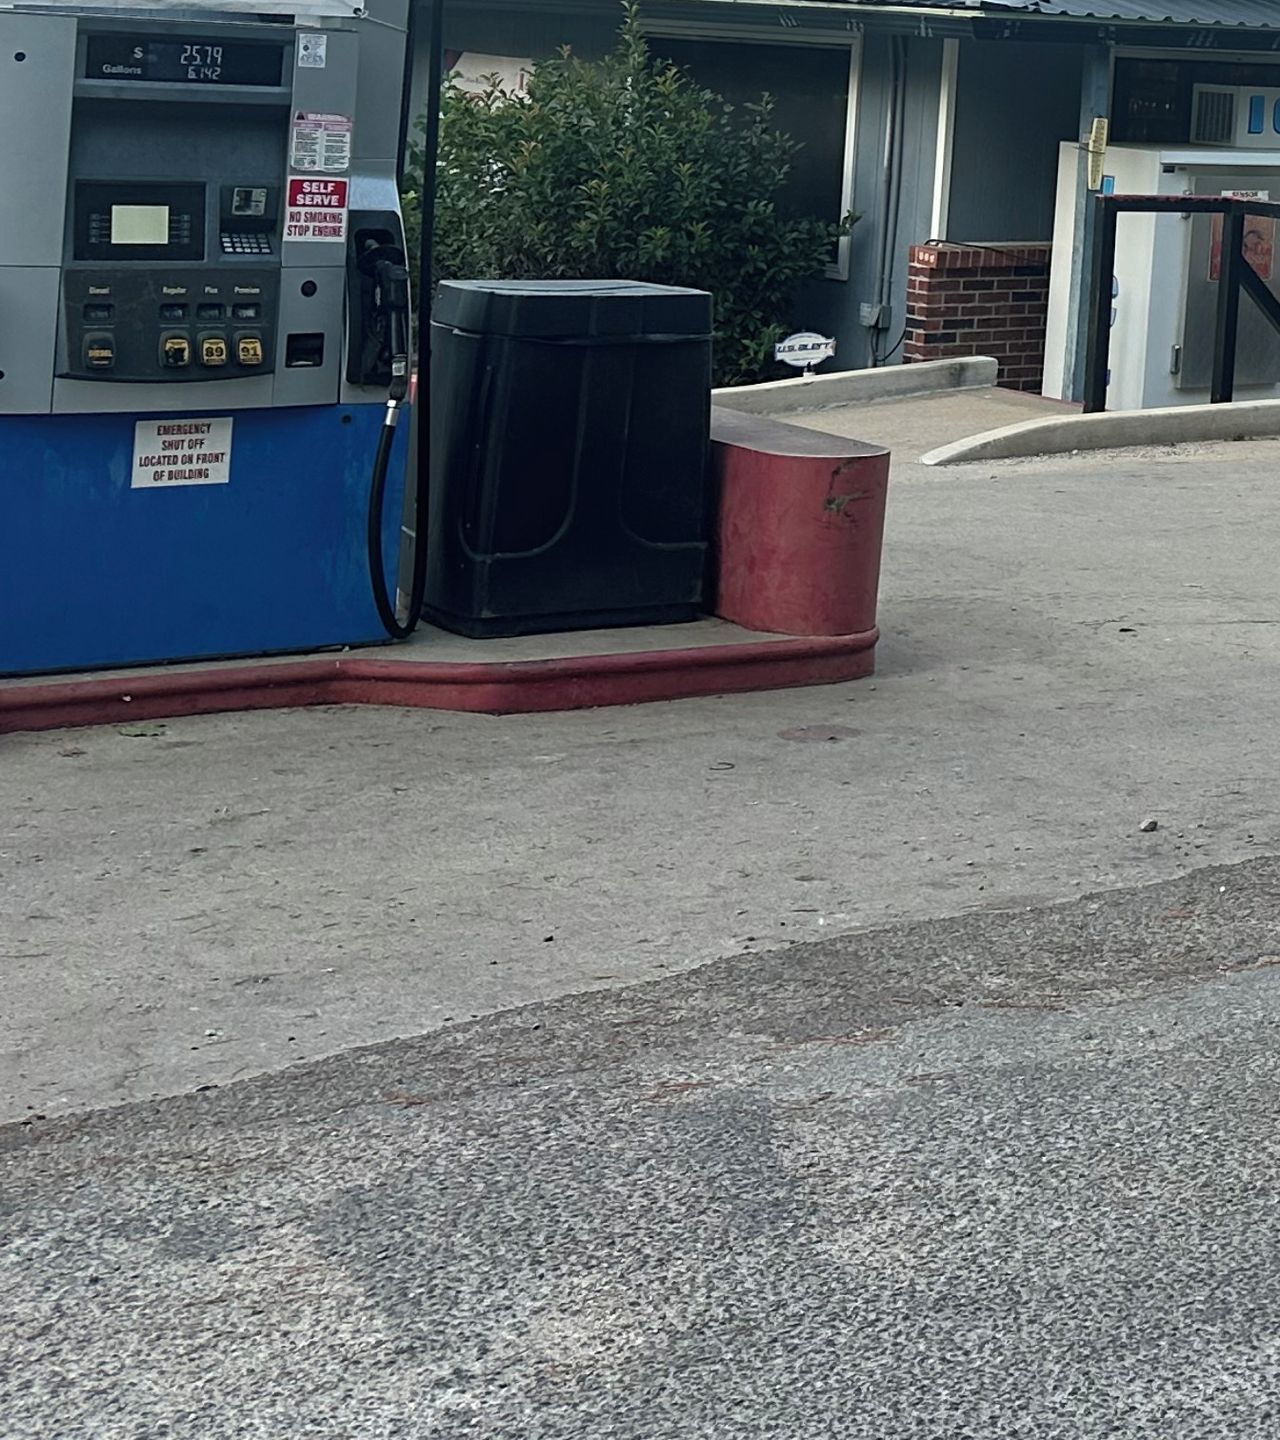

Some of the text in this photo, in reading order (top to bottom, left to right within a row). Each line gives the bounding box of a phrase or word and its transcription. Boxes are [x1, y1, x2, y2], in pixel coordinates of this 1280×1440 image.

[102, 64, 142, 75] Gallons
[302, 181, 336, 194] SELF
[296, 193, 340, 206] SERVE
[288, 211, 343, 224] NO SMOKING
[287, 224, 343, 238] STOP ENGINE
[204, 346, 224, 358] 89
[240, 346, 260, 357] 91
[157, 423, 211, 436] EMERGENCY
[161, 438, 205, 451] SHUT OFF
[139, 452, 225, 467] LOCATED ON FRONT
[153, 467, 209, 481] OF BUILDING
